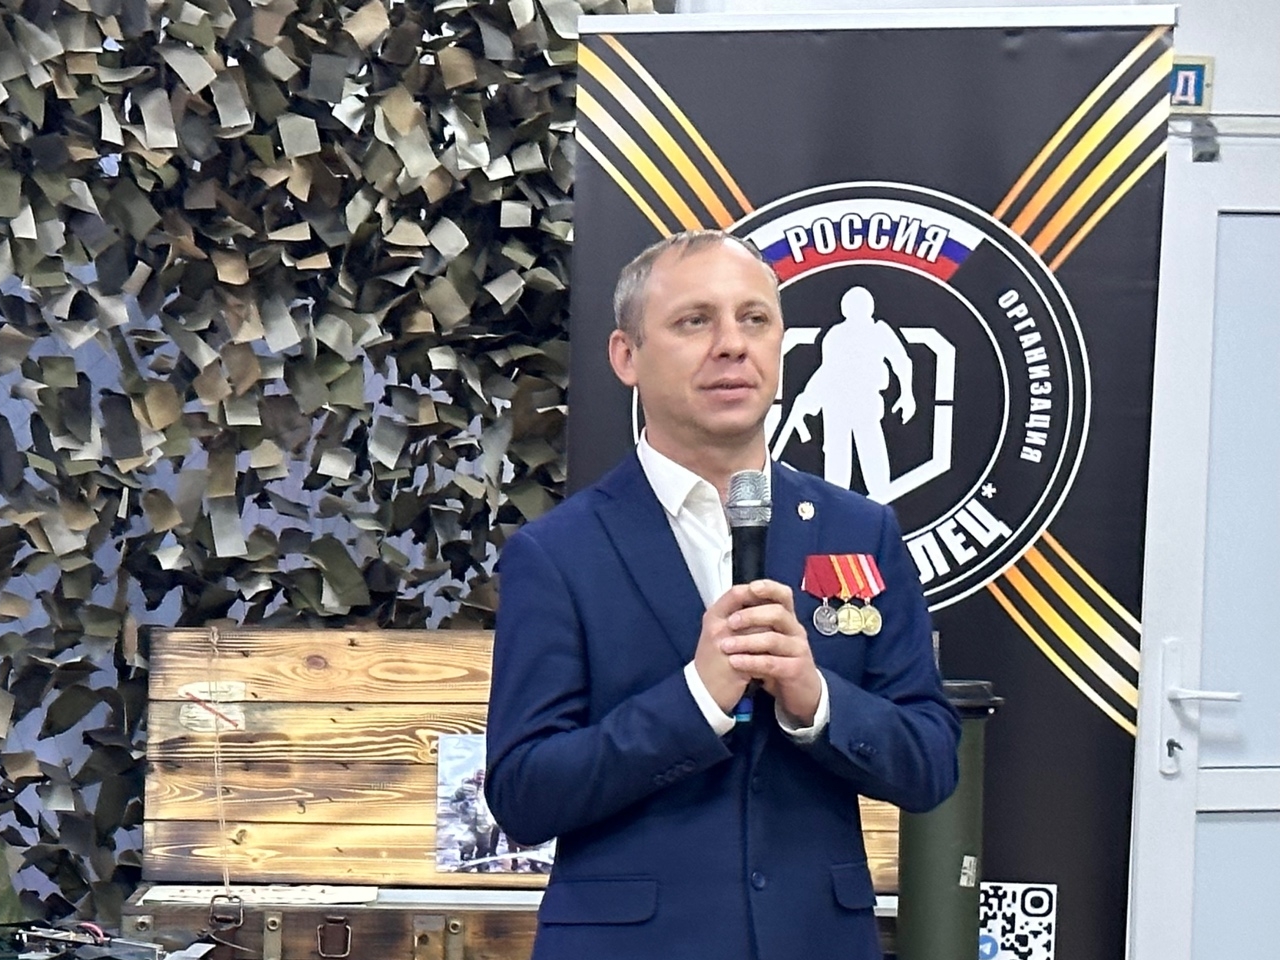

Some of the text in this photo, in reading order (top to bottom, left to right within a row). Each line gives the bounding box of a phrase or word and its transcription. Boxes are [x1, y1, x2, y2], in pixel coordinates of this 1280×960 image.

[784, 212, 950, 264] РОССИЯ
[998, 289, 1052, 463] ОРГАНИЗАЦИЯ
[906, 498, 1013, 585] ЛЕЦ
